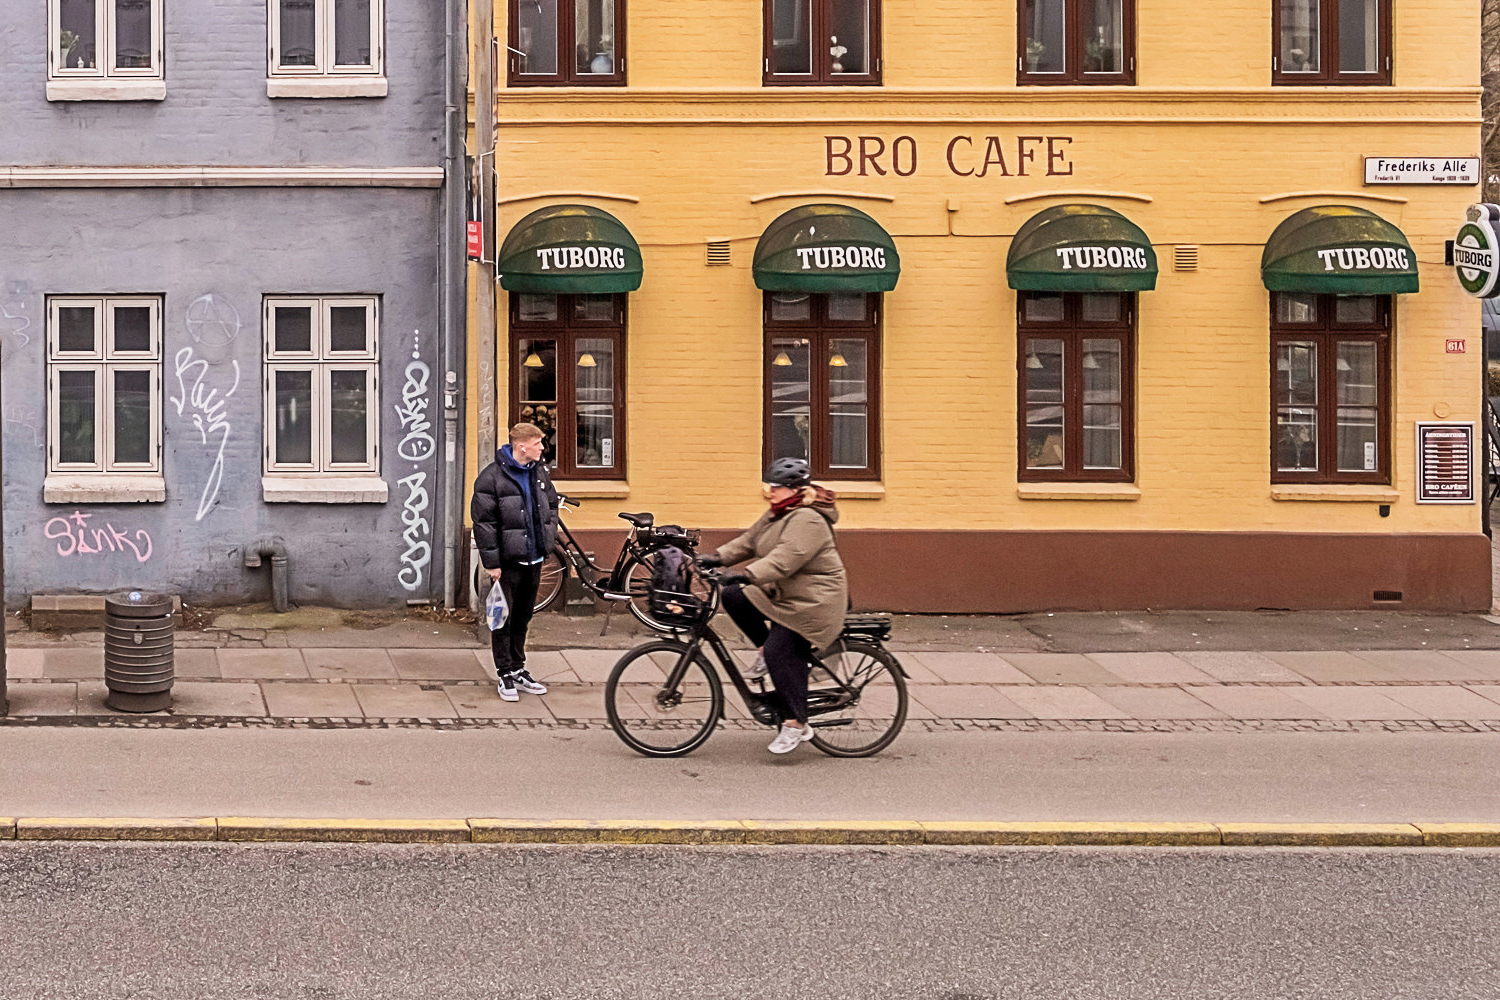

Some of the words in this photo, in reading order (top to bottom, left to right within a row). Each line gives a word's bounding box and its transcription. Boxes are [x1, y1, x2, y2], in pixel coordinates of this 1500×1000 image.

[825, 135, 917, 177] BRO
[946, 135, 1073, 178] CAFE
[1378, 160, 1435, 172] Frederiks
[1443, 160, 1467, 172] Allé
[537, 246, 625, 270] TUBORG
[797, 246, 886, 270] TUBORG
[1057, 247, 1147, 270] TUBORG
[1318, 247, 1409, 271] TUBORG
[1454, 248, 1492, 268] TUBORG
[1448, 341, 1463, 351] 61A
